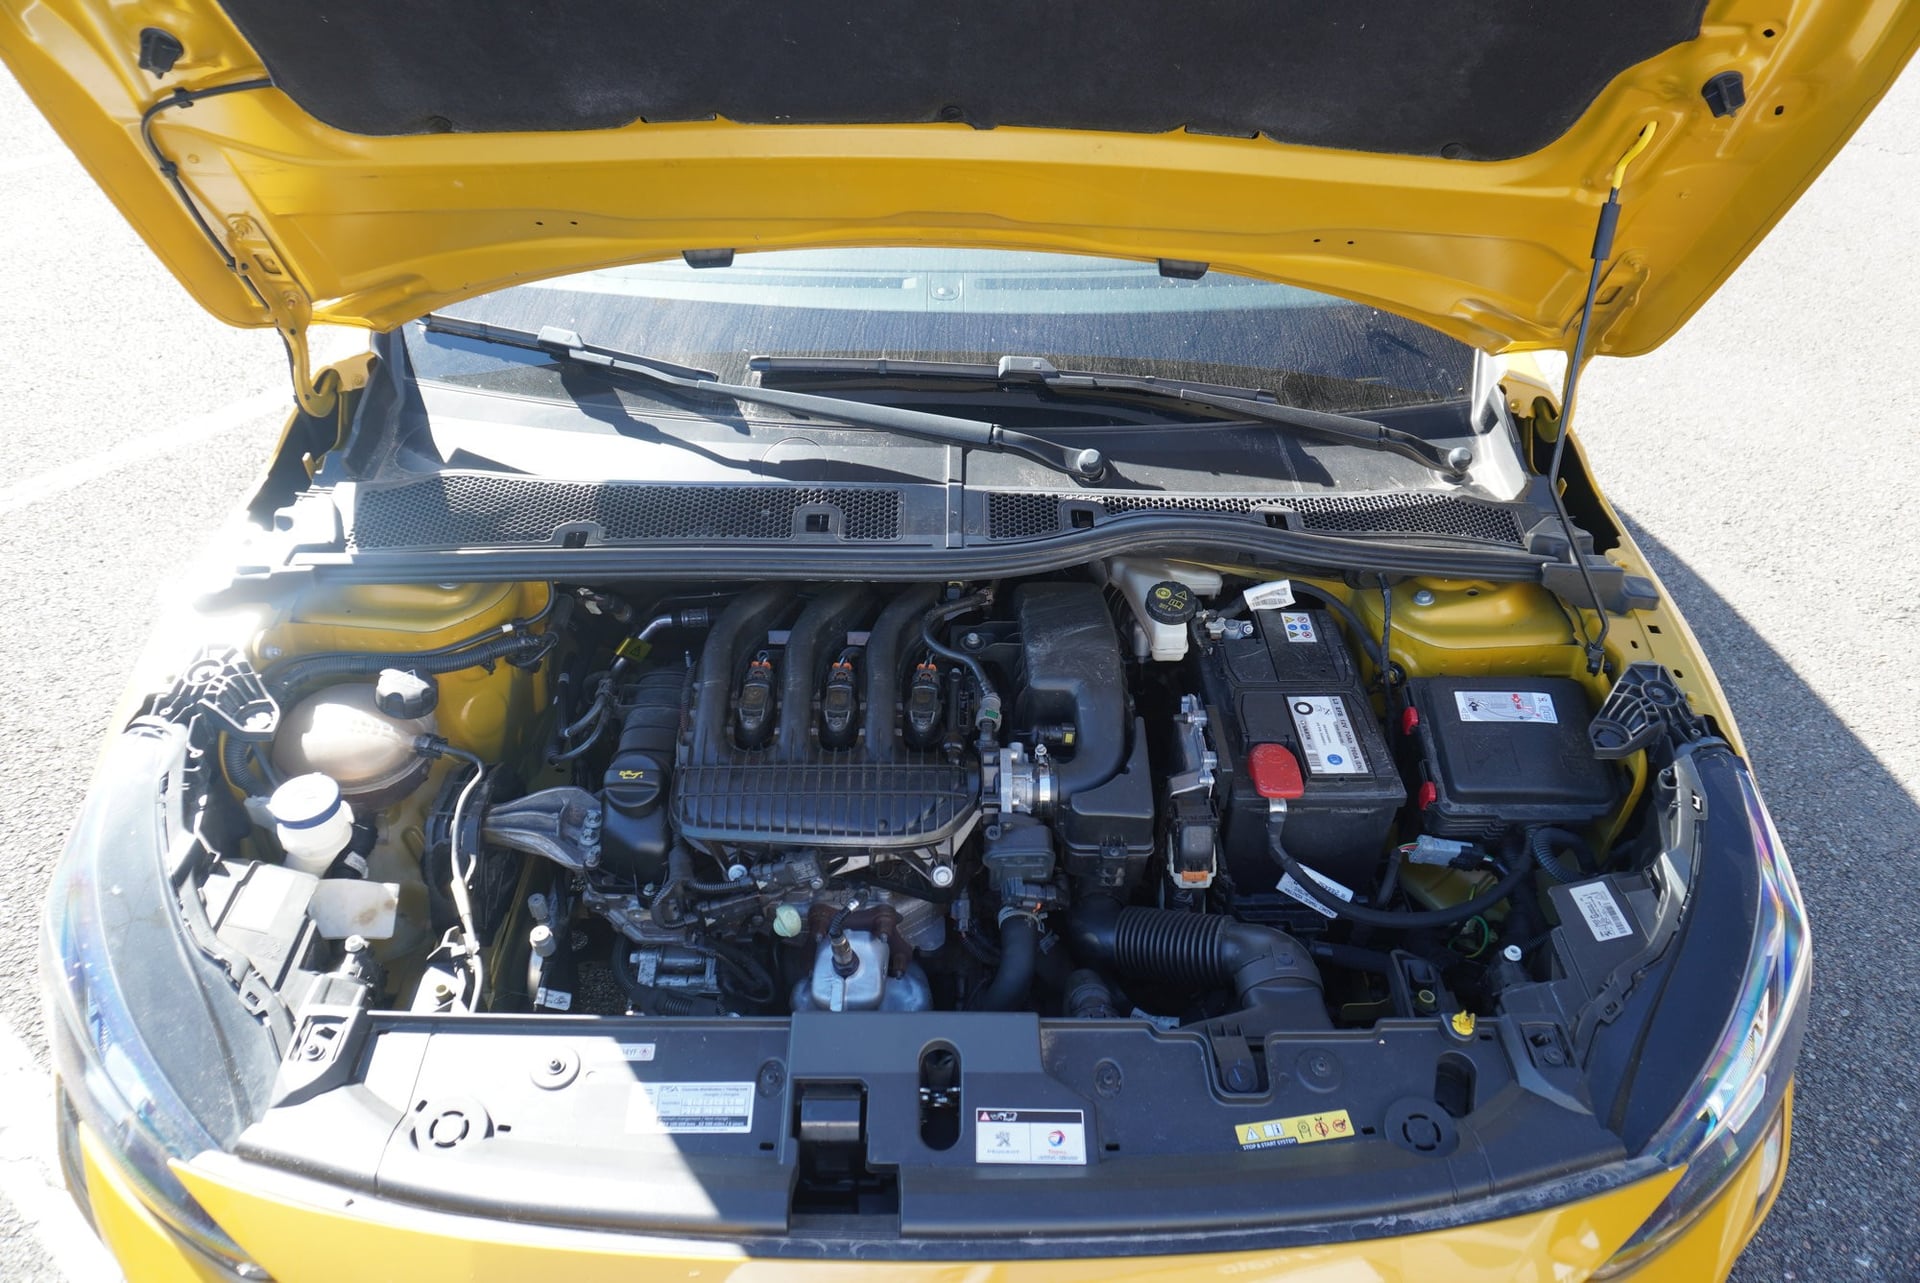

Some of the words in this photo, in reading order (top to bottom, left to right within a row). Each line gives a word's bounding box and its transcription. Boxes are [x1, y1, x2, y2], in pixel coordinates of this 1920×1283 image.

[1339, 719, 1348, 728] 12V
[1242, 1143, 1256, 1151] STOP
[1261, 1140, 1277, 1148] START
[1277, 1138, 1297, 1147] SYSTEM
